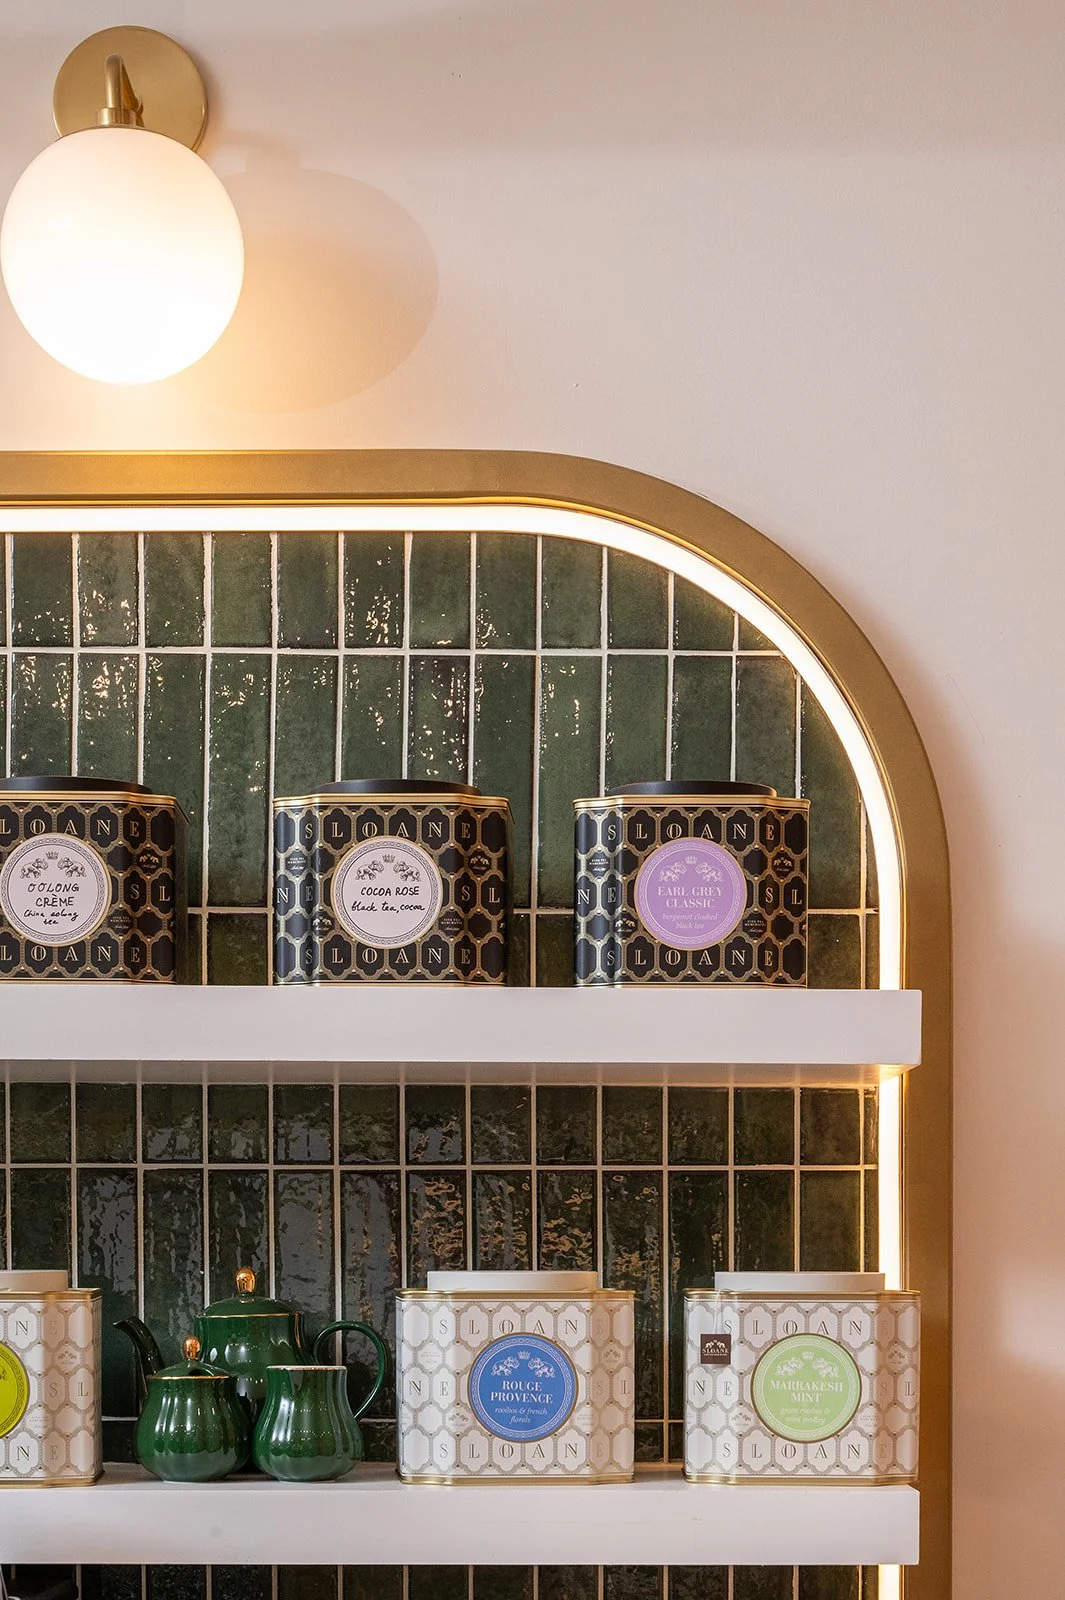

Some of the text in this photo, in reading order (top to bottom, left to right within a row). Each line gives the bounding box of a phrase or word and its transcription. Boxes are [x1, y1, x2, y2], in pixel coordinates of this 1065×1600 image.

[305, 821, 471, 839] SLOANE
[607, 823, 775, 841] SLOANE
[27, 882, 79, 893] OOLONG
[360, 885, 420, 896] COCOA ROSE
[658, 886, 724, 897] EARL GREY
[36, 893, 74, 907] CRÈME
[665, 899, 715, 909] CLASSIC
[351, 900, 378, 912] black
[662, 913, 693, 922] bergamot
[305, 947, 471, 965] SLOANE
[606, 949, 773, 966] SLOANE
[502, 1381, 542, 1392] ROUGE
[770, 1380, 843, 1392] MARRAKESH
[490, 1392, 553, 1403] PROVENCE
[791, 1392, 822, 1403] MINT
[494, 1407, 518, 1415] rooibos
[526, 1407, 547, 1416] french
[510, 1415, 531, 1424] florals
